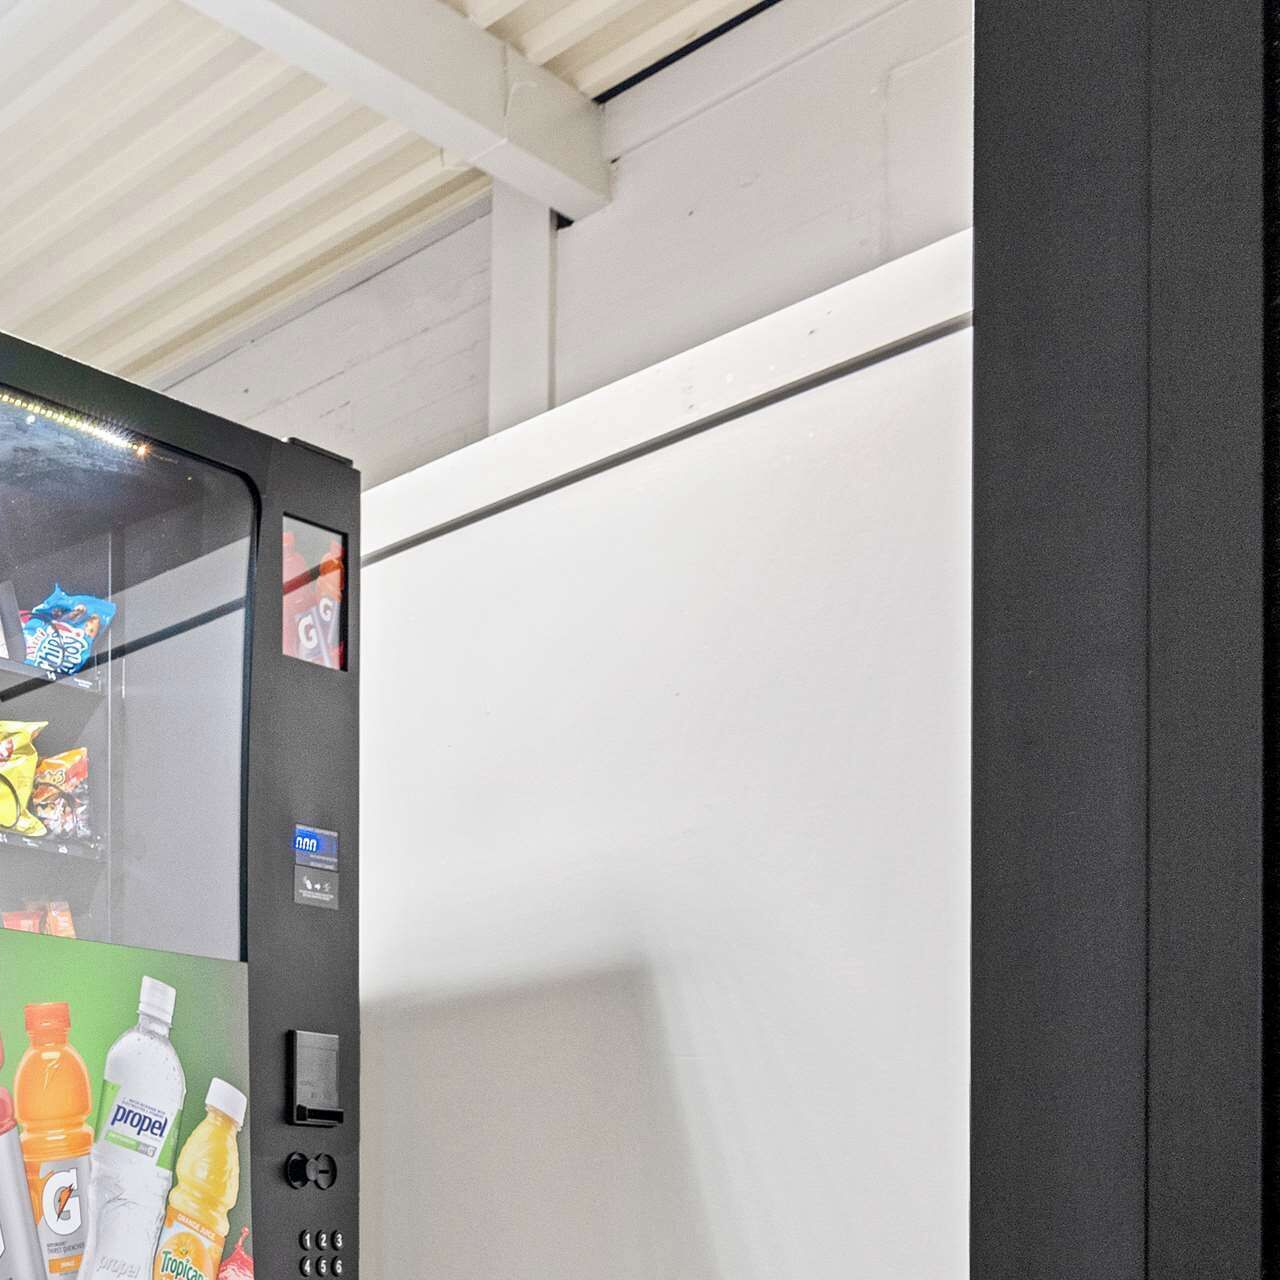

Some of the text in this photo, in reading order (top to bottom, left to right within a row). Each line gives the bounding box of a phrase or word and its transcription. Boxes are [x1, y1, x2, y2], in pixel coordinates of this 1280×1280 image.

[320, 597, 333, 622] G
[298, 614, 318, 649] G
[110, 1104, 168, 1138] propel
[43, 1168, 81, 1235] G
[304, 1233, 311, 1248] 1
[320, 1233, 327, 1247] 2
[336, 1233, 343, 1247] 3
[304, 1259, 311, 1273] 4
[320, 1259, 327, 1273] 5
[335, 1259, 342, 1273] 6
